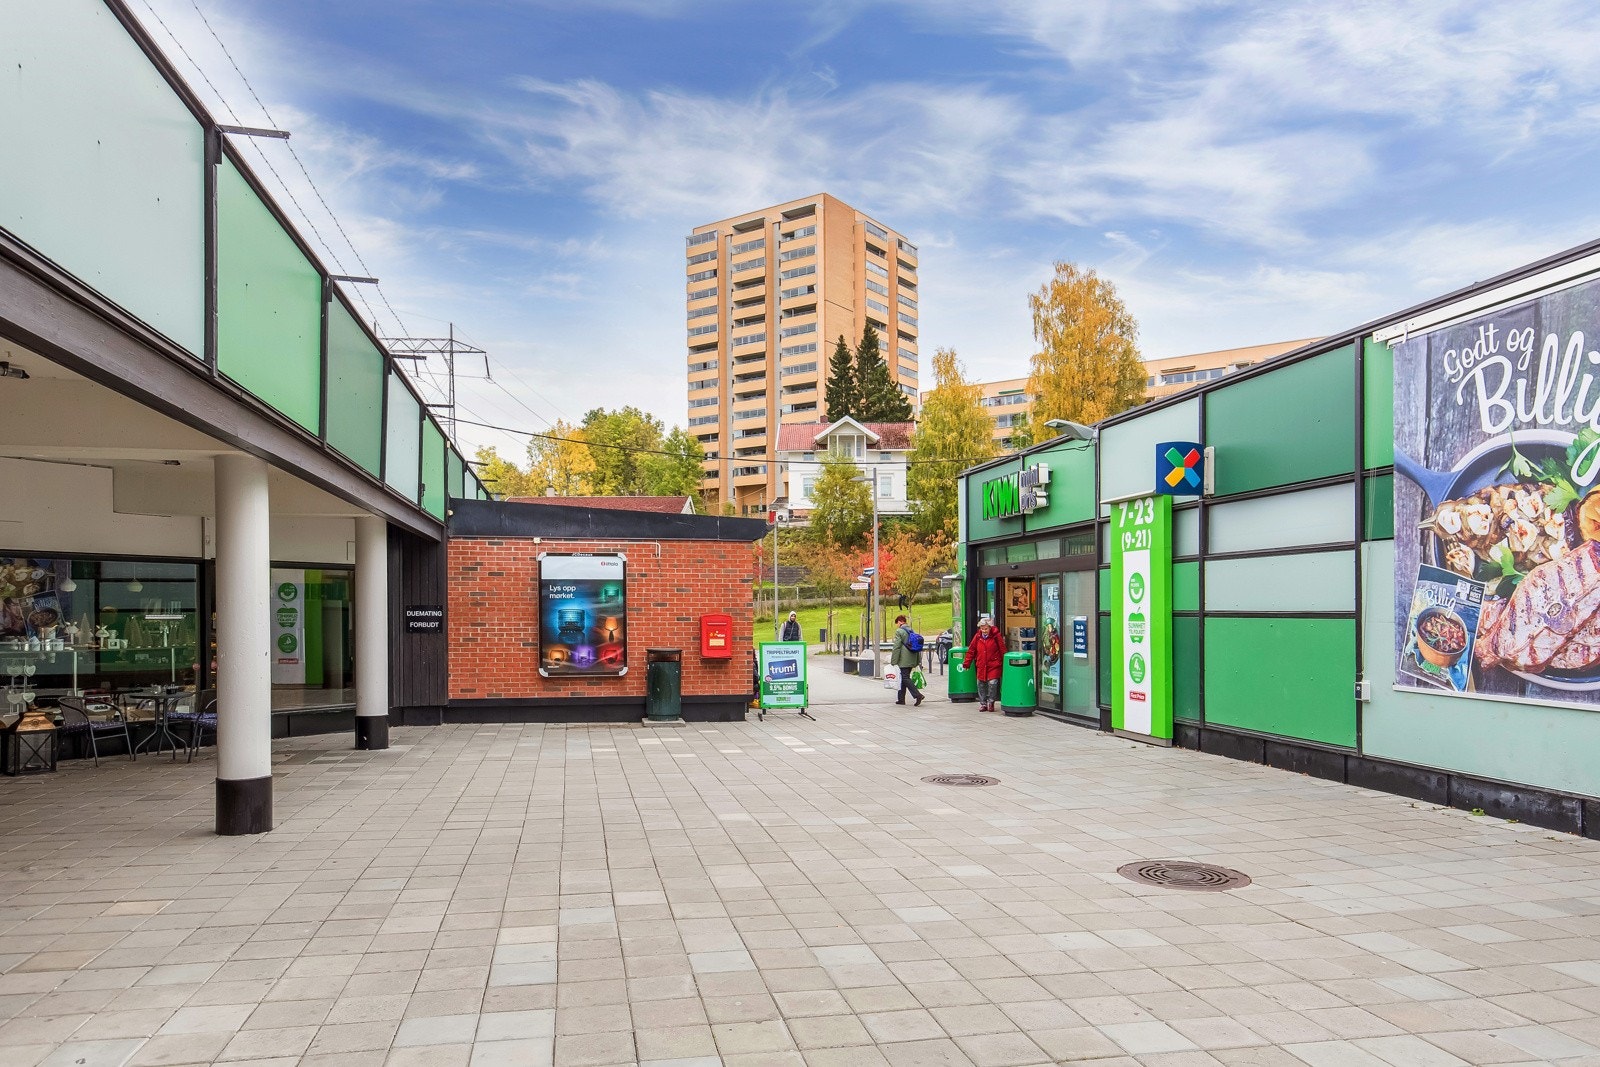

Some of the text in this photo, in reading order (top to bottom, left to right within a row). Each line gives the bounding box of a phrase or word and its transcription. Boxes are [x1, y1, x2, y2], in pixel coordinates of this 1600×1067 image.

[1443, 323, 1535, 383] Godt og
[982, 471, 1020, 521] KIWI
[1118, 497, 1154, 528] 7-23
[1121, 529, 1152, 551] (9-21)
[562, 585, 576, 593] opp
[1422, 587, 1457, 618] Billig
[771, 663, 796, 674] trumf
